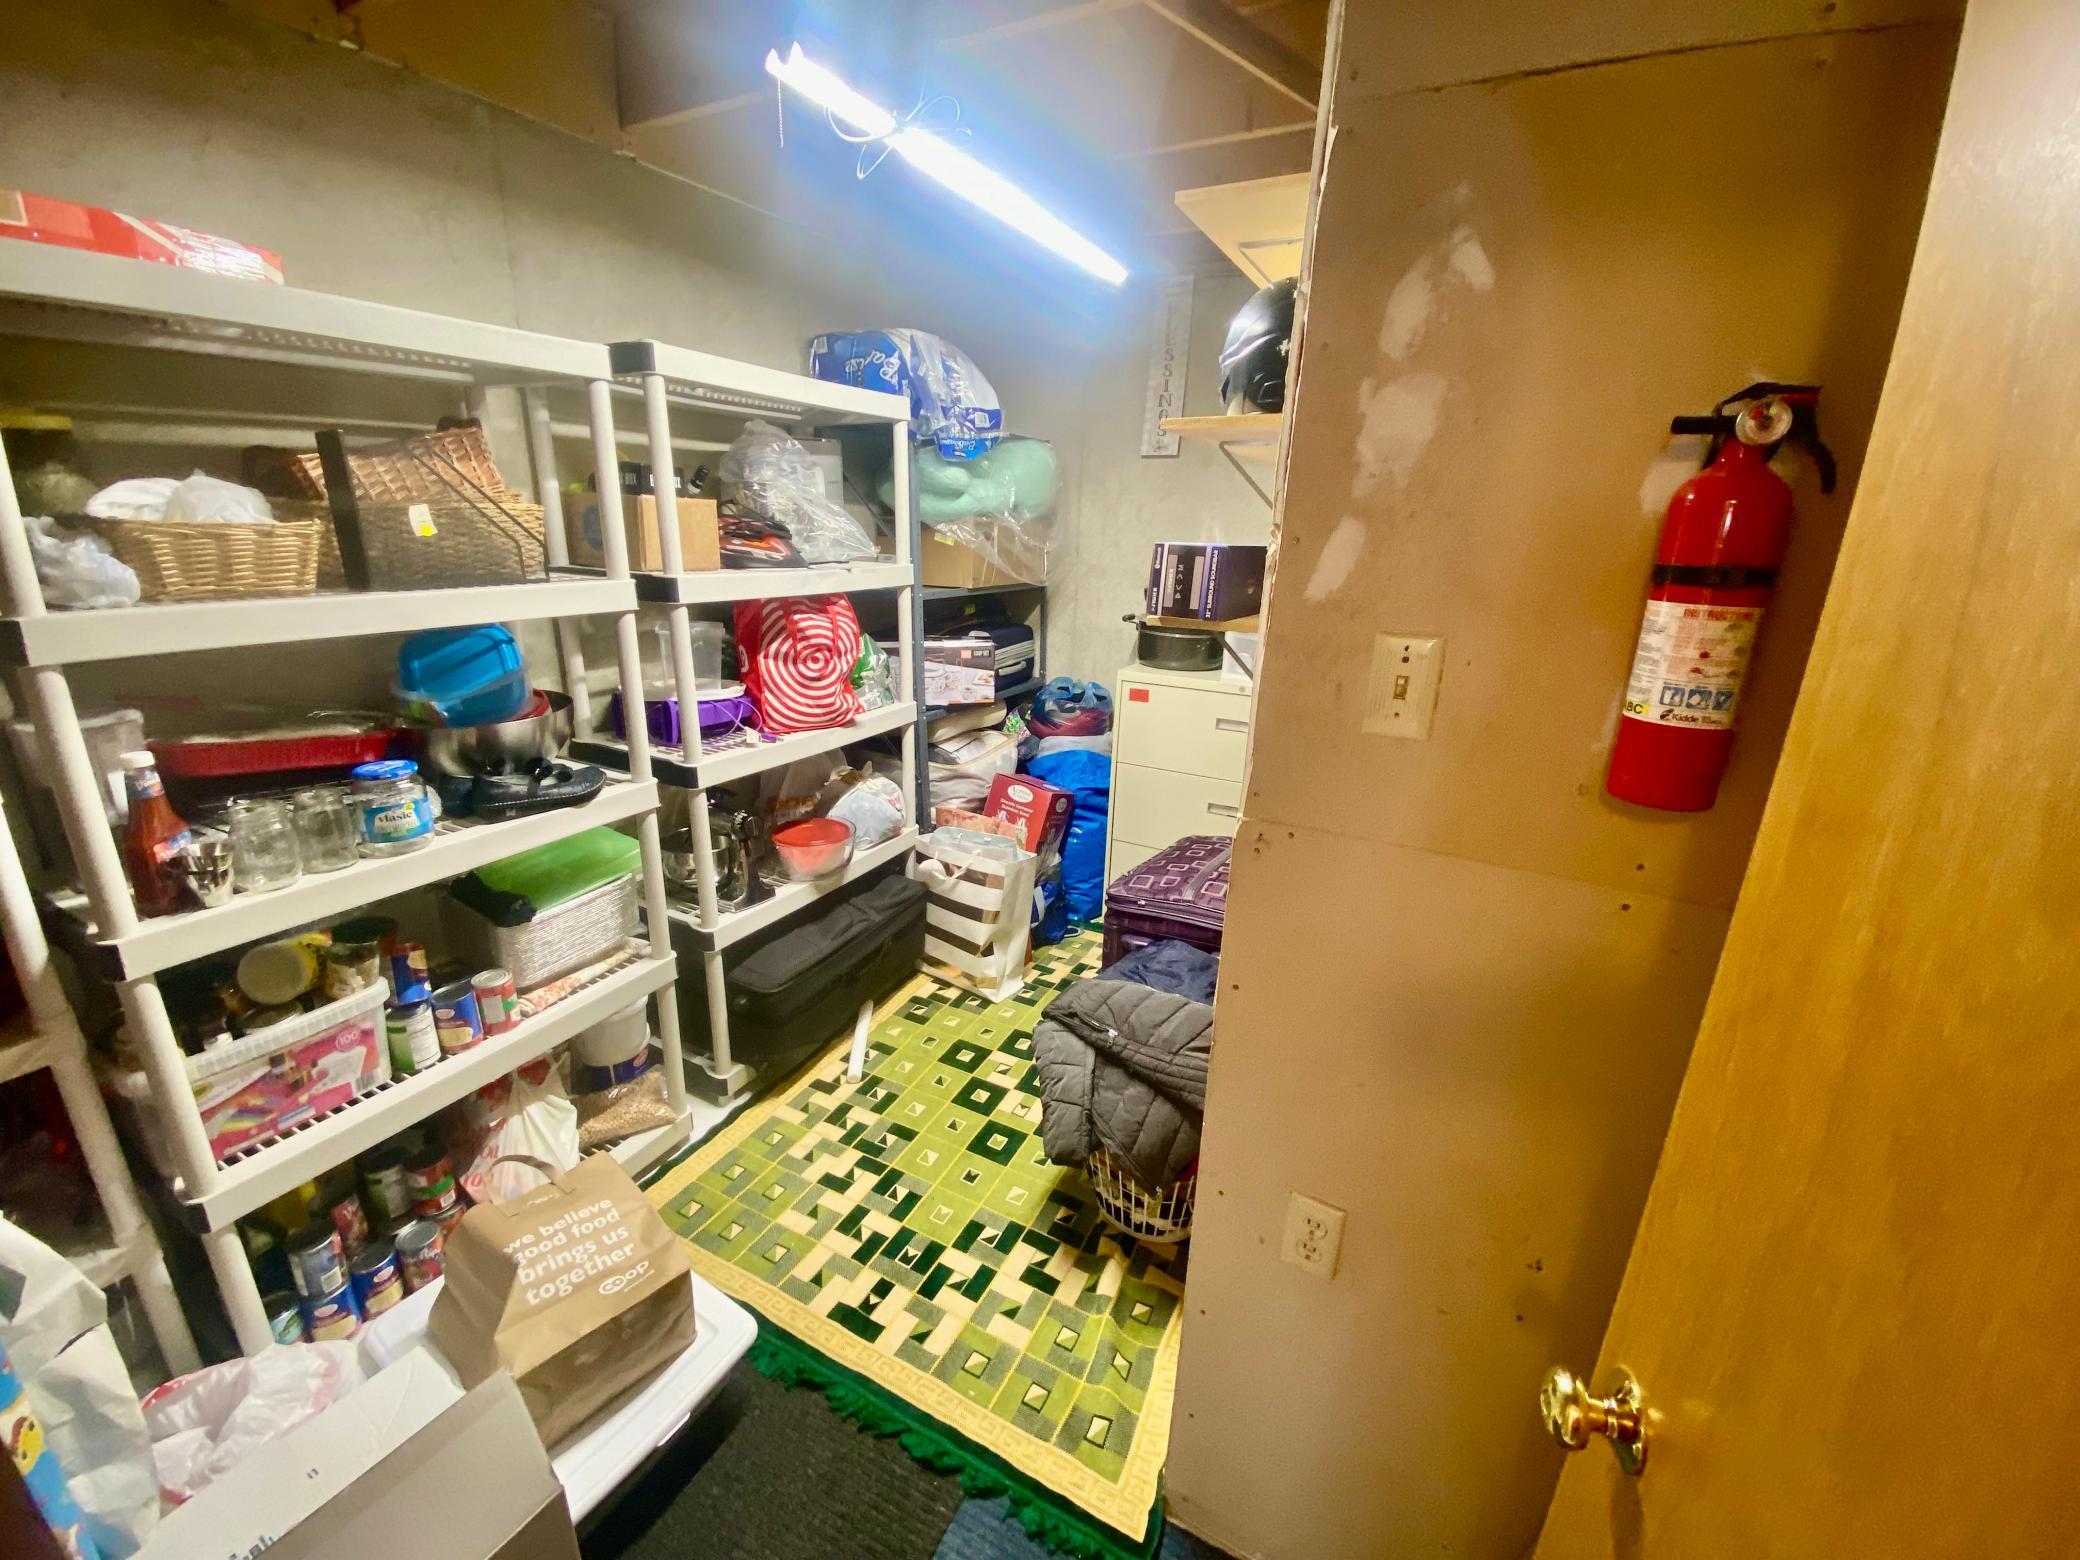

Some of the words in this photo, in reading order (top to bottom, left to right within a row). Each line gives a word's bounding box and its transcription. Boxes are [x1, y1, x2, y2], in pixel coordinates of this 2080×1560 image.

[1206, 581, 1215, 609] SURROUND
[1672, 713, 1699, 724] Kidde
[503, 1234, 536, 1254] we
[538, 1199, 613, 1236] believe
[513, 1231, 568, 1267] good
[571, 1207, 620, 1238] food
[518, 1240, 598, 1286] brings
[602, 1226, 630, 1245] us
[526, 1243, 635, 1305] together
